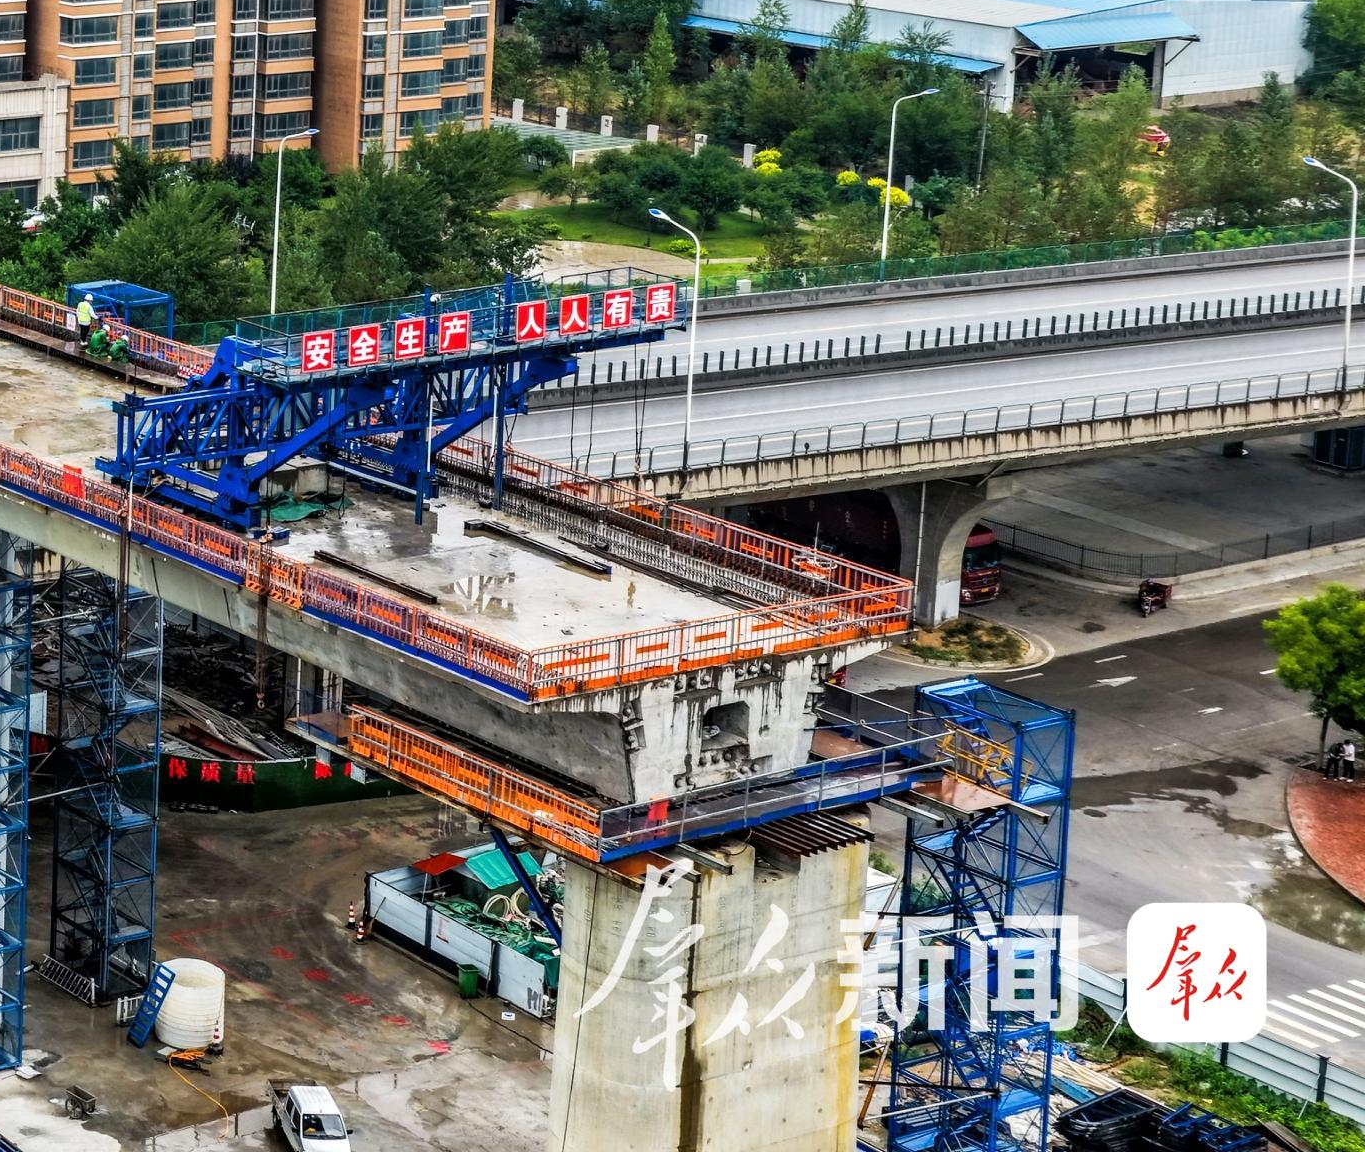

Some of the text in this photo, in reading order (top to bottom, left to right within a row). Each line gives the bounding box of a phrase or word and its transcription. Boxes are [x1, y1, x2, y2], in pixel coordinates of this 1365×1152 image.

[306, 285, 673, 370] 安全生产 人人有责
